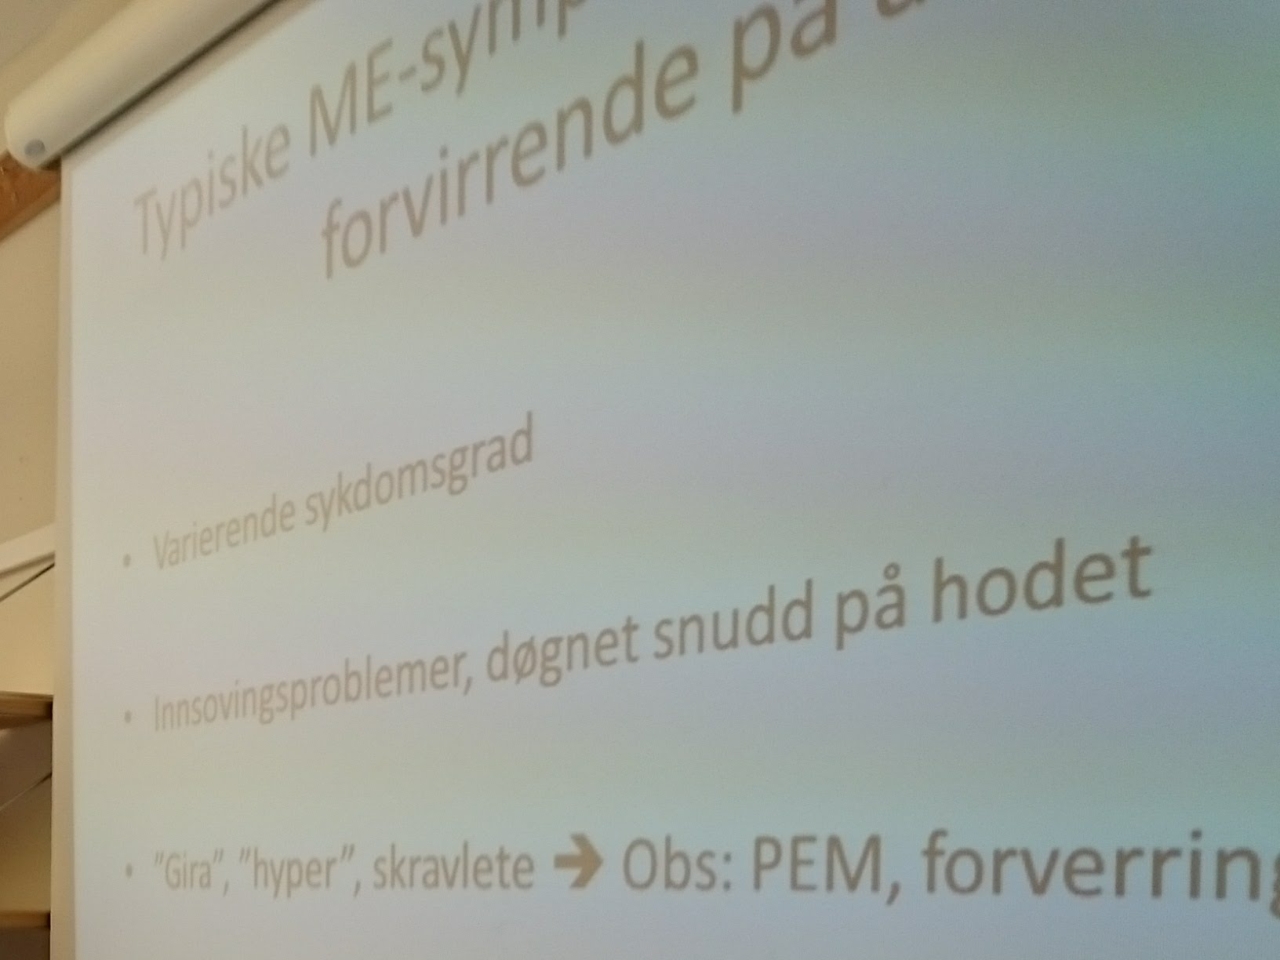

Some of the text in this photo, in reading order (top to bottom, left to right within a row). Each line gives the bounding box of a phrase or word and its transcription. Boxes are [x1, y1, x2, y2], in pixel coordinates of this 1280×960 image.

[133, 122, 291, 262] Typiske
[321, 37, 700, 280] forvirrende
[153, 410, 534, 571] Varierende sykdomsgrad
[153, 535, 1154, 732] Innsovingsproblemer, døgnet snudd på hodet
[372, 840, 536, 892] skravlete
[622, 834, 733, 893] Obs:
[752, 833, 902, 907] PEM,
[921, 828, 1280, 920] forverrin
